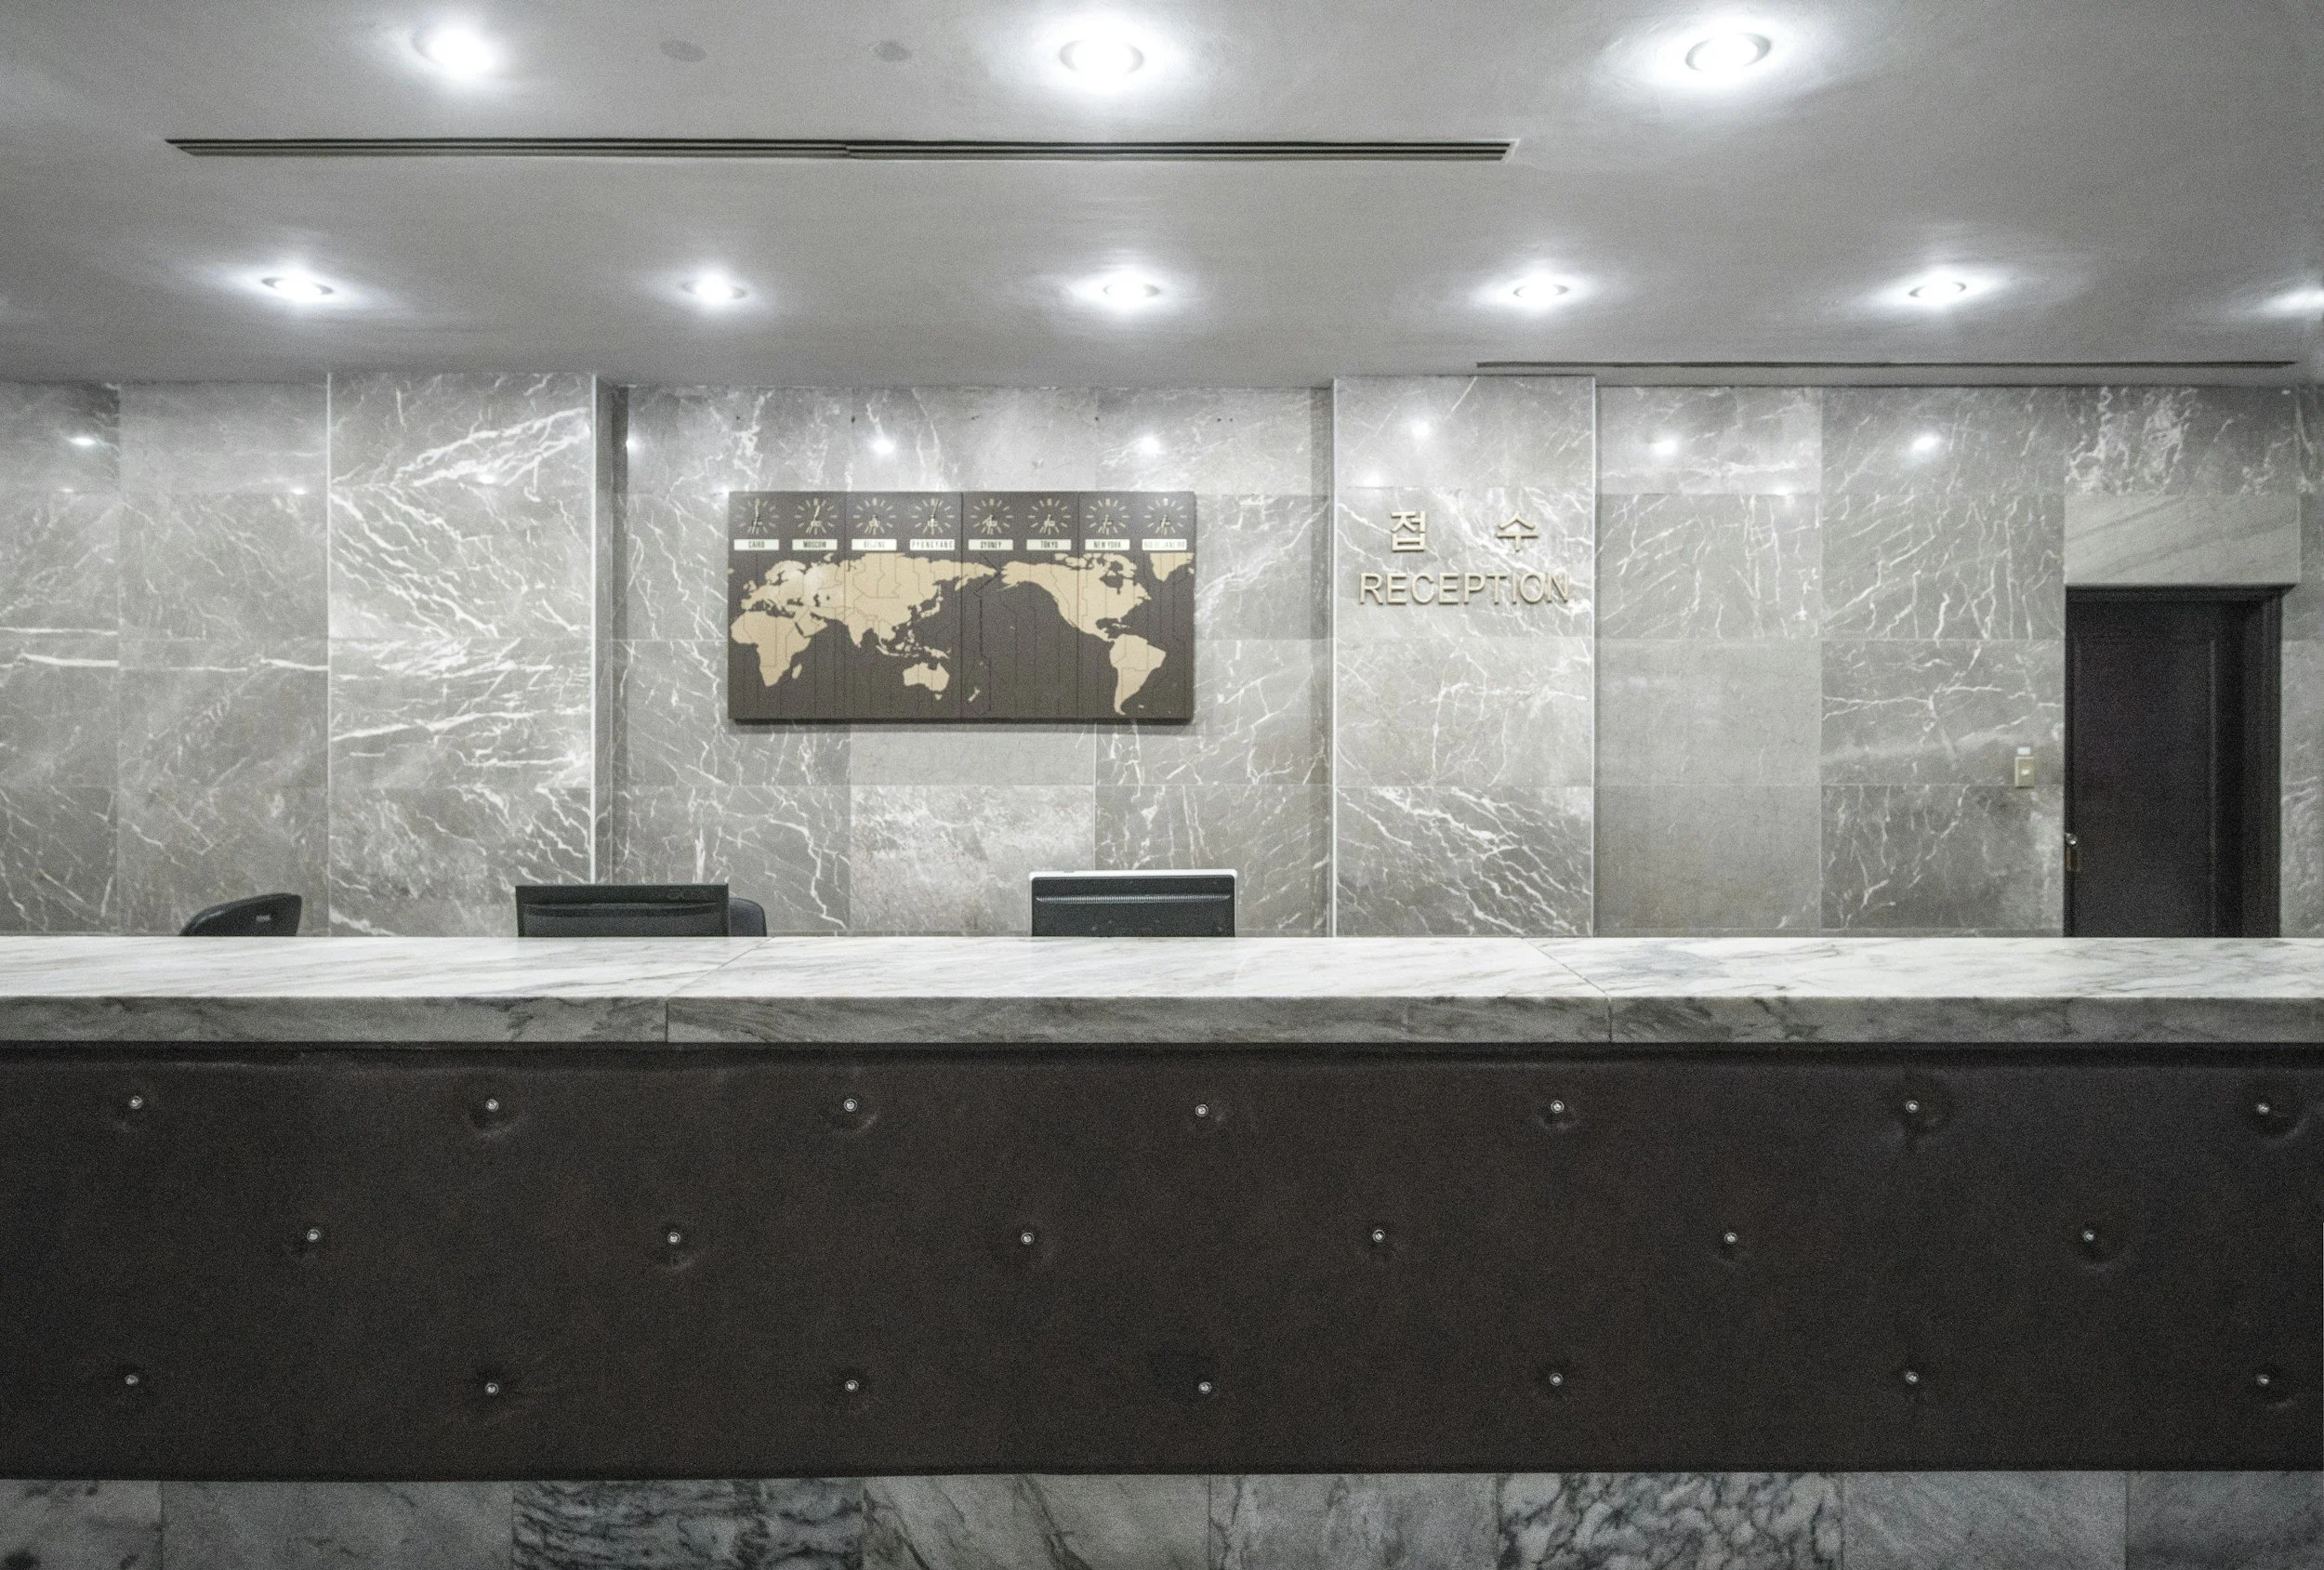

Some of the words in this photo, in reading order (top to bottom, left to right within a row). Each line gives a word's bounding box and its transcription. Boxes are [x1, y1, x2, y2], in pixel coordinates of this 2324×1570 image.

[748, 540, 765, 548] CAIRO
[802, 540, 826, 548] MOSCOW
[864, 540, 885, 548] BEIJING
[912, 540, 953, 548] PYONGYANG
[980, 540, 1002, 548] SYDNEY
[1040, 540, 1058, 548] TOKYO
[1093, 540, 1106, 548] NEW
[1107, 540, 1121, 548] YORK
[1359, 572, 1570, 606] RECEPTION
